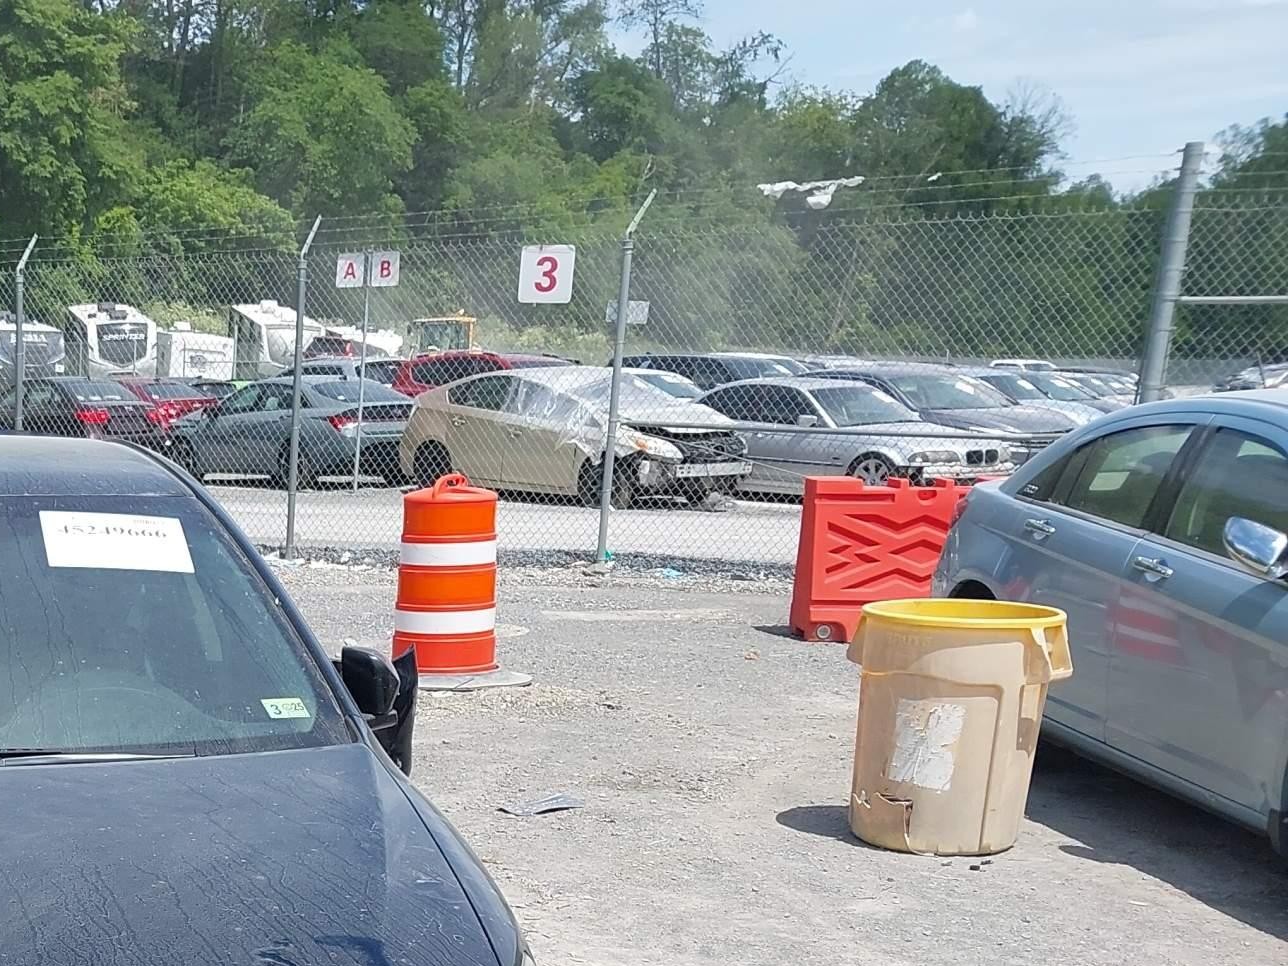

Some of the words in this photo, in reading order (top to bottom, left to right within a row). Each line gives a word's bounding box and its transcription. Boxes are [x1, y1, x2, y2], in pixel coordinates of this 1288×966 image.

[343, 262, 356, 279] A
[380, 260, 391, 278] B
[534, 256, 559, 293] 3
[102, 333, 145, 341] SPRINTER
[270, 704, 282, 716] 3
